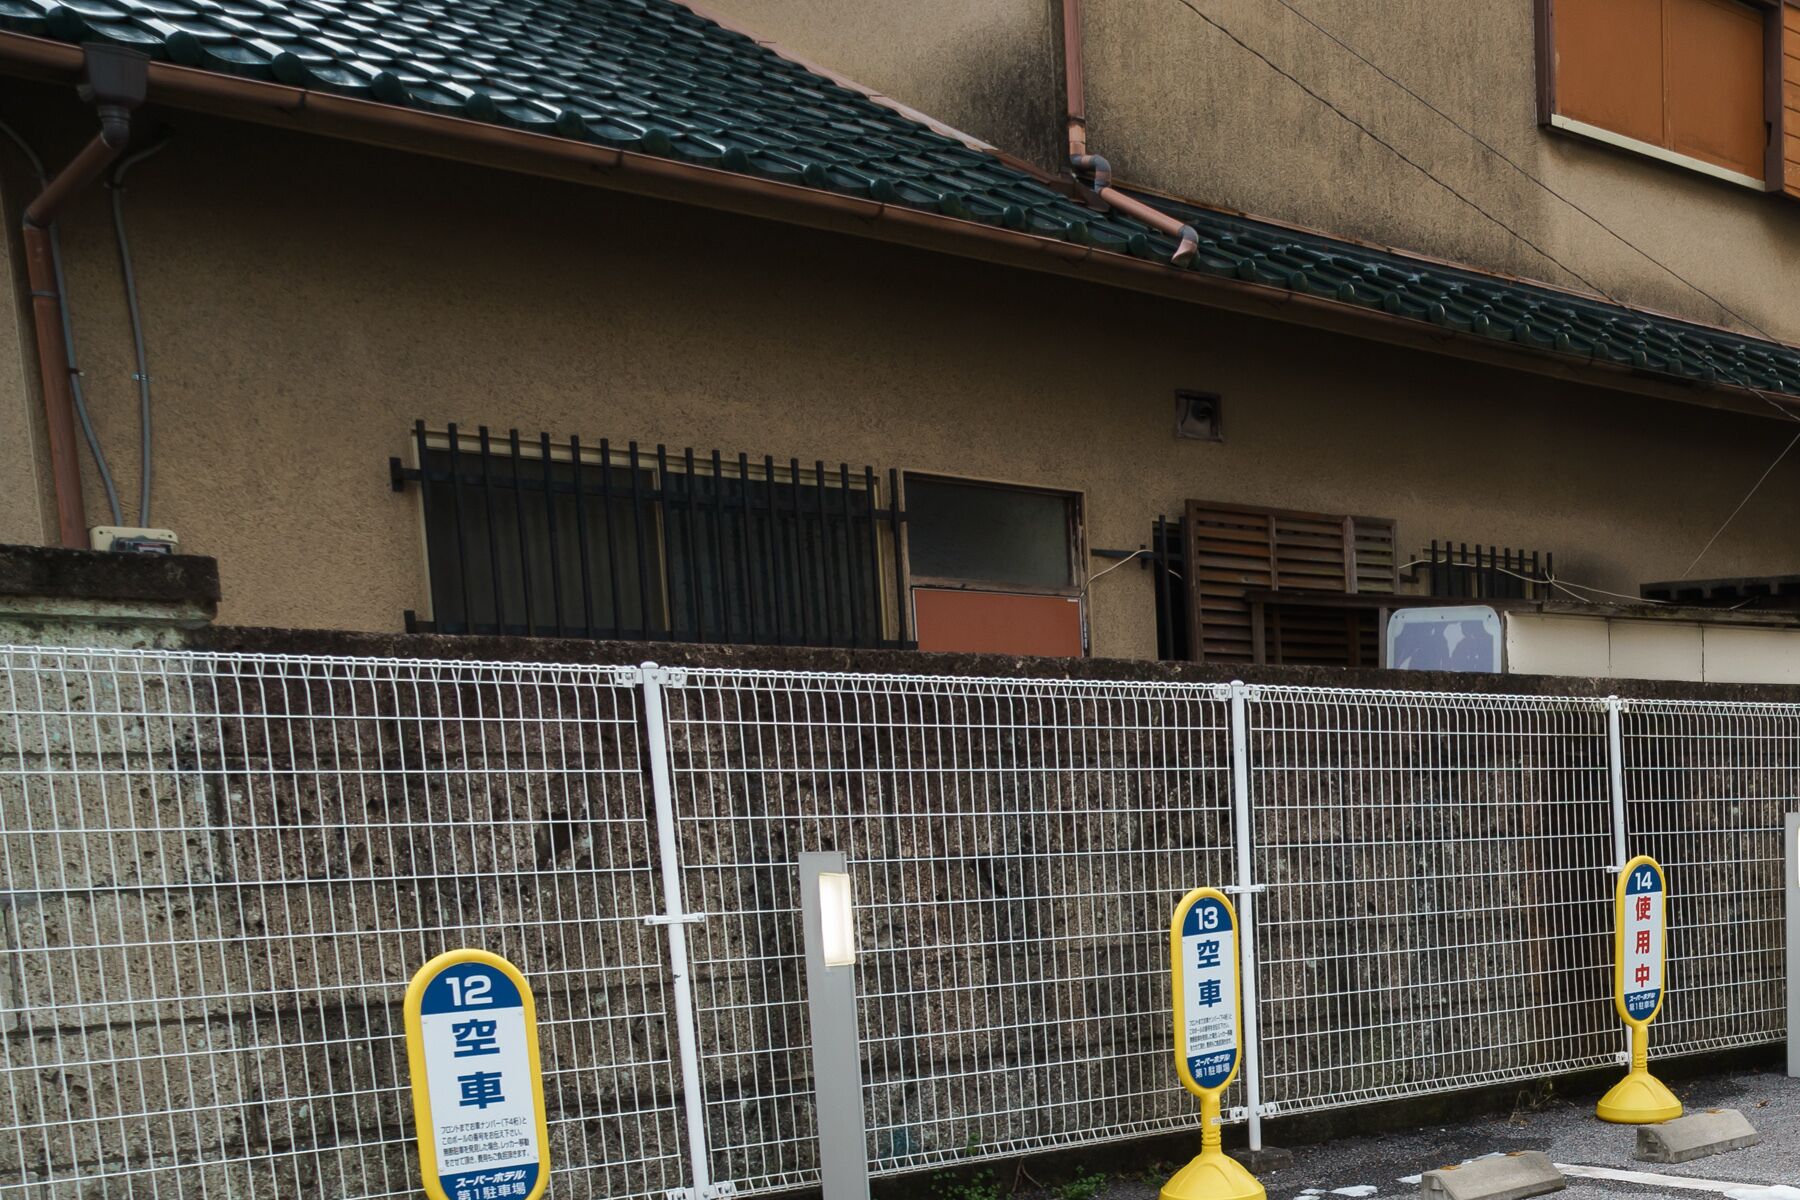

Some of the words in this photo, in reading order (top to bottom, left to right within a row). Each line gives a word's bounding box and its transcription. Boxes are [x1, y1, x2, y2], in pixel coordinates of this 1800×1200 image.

[1635, 871, 1653, 891] 14
[1195, 906, 1218, 930] 13
[1635, 896, 1651, 988] 使用中
[445, 974, 493, 1006] 12
[1197, 940, 1222, 1008] 空車
[452, 1018, 505, 1109] 空車
[455, 1169, 526, 1188] スーパーホテル
